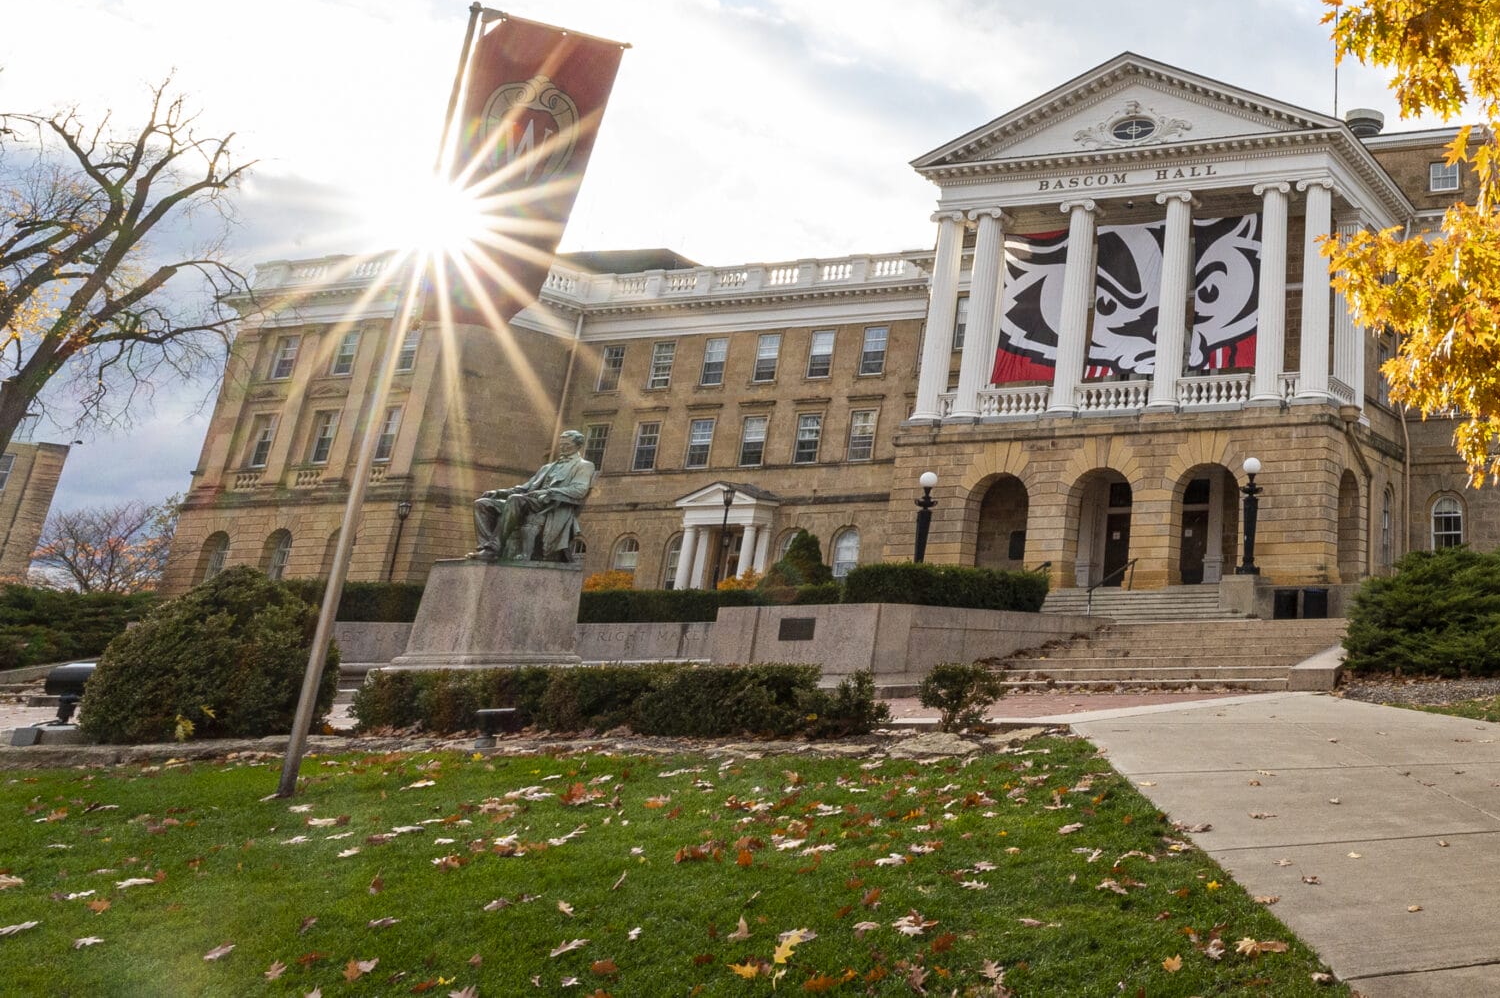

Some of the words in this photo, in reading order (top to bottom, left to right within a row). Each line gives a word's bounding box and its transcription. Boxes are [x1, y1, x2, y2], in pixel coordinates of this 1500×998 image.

[1038, 173, 1128, 191] BASCOM
[1155, 165, 1217, 181] HALL
[596, 631, 648, 643] RIGHT
